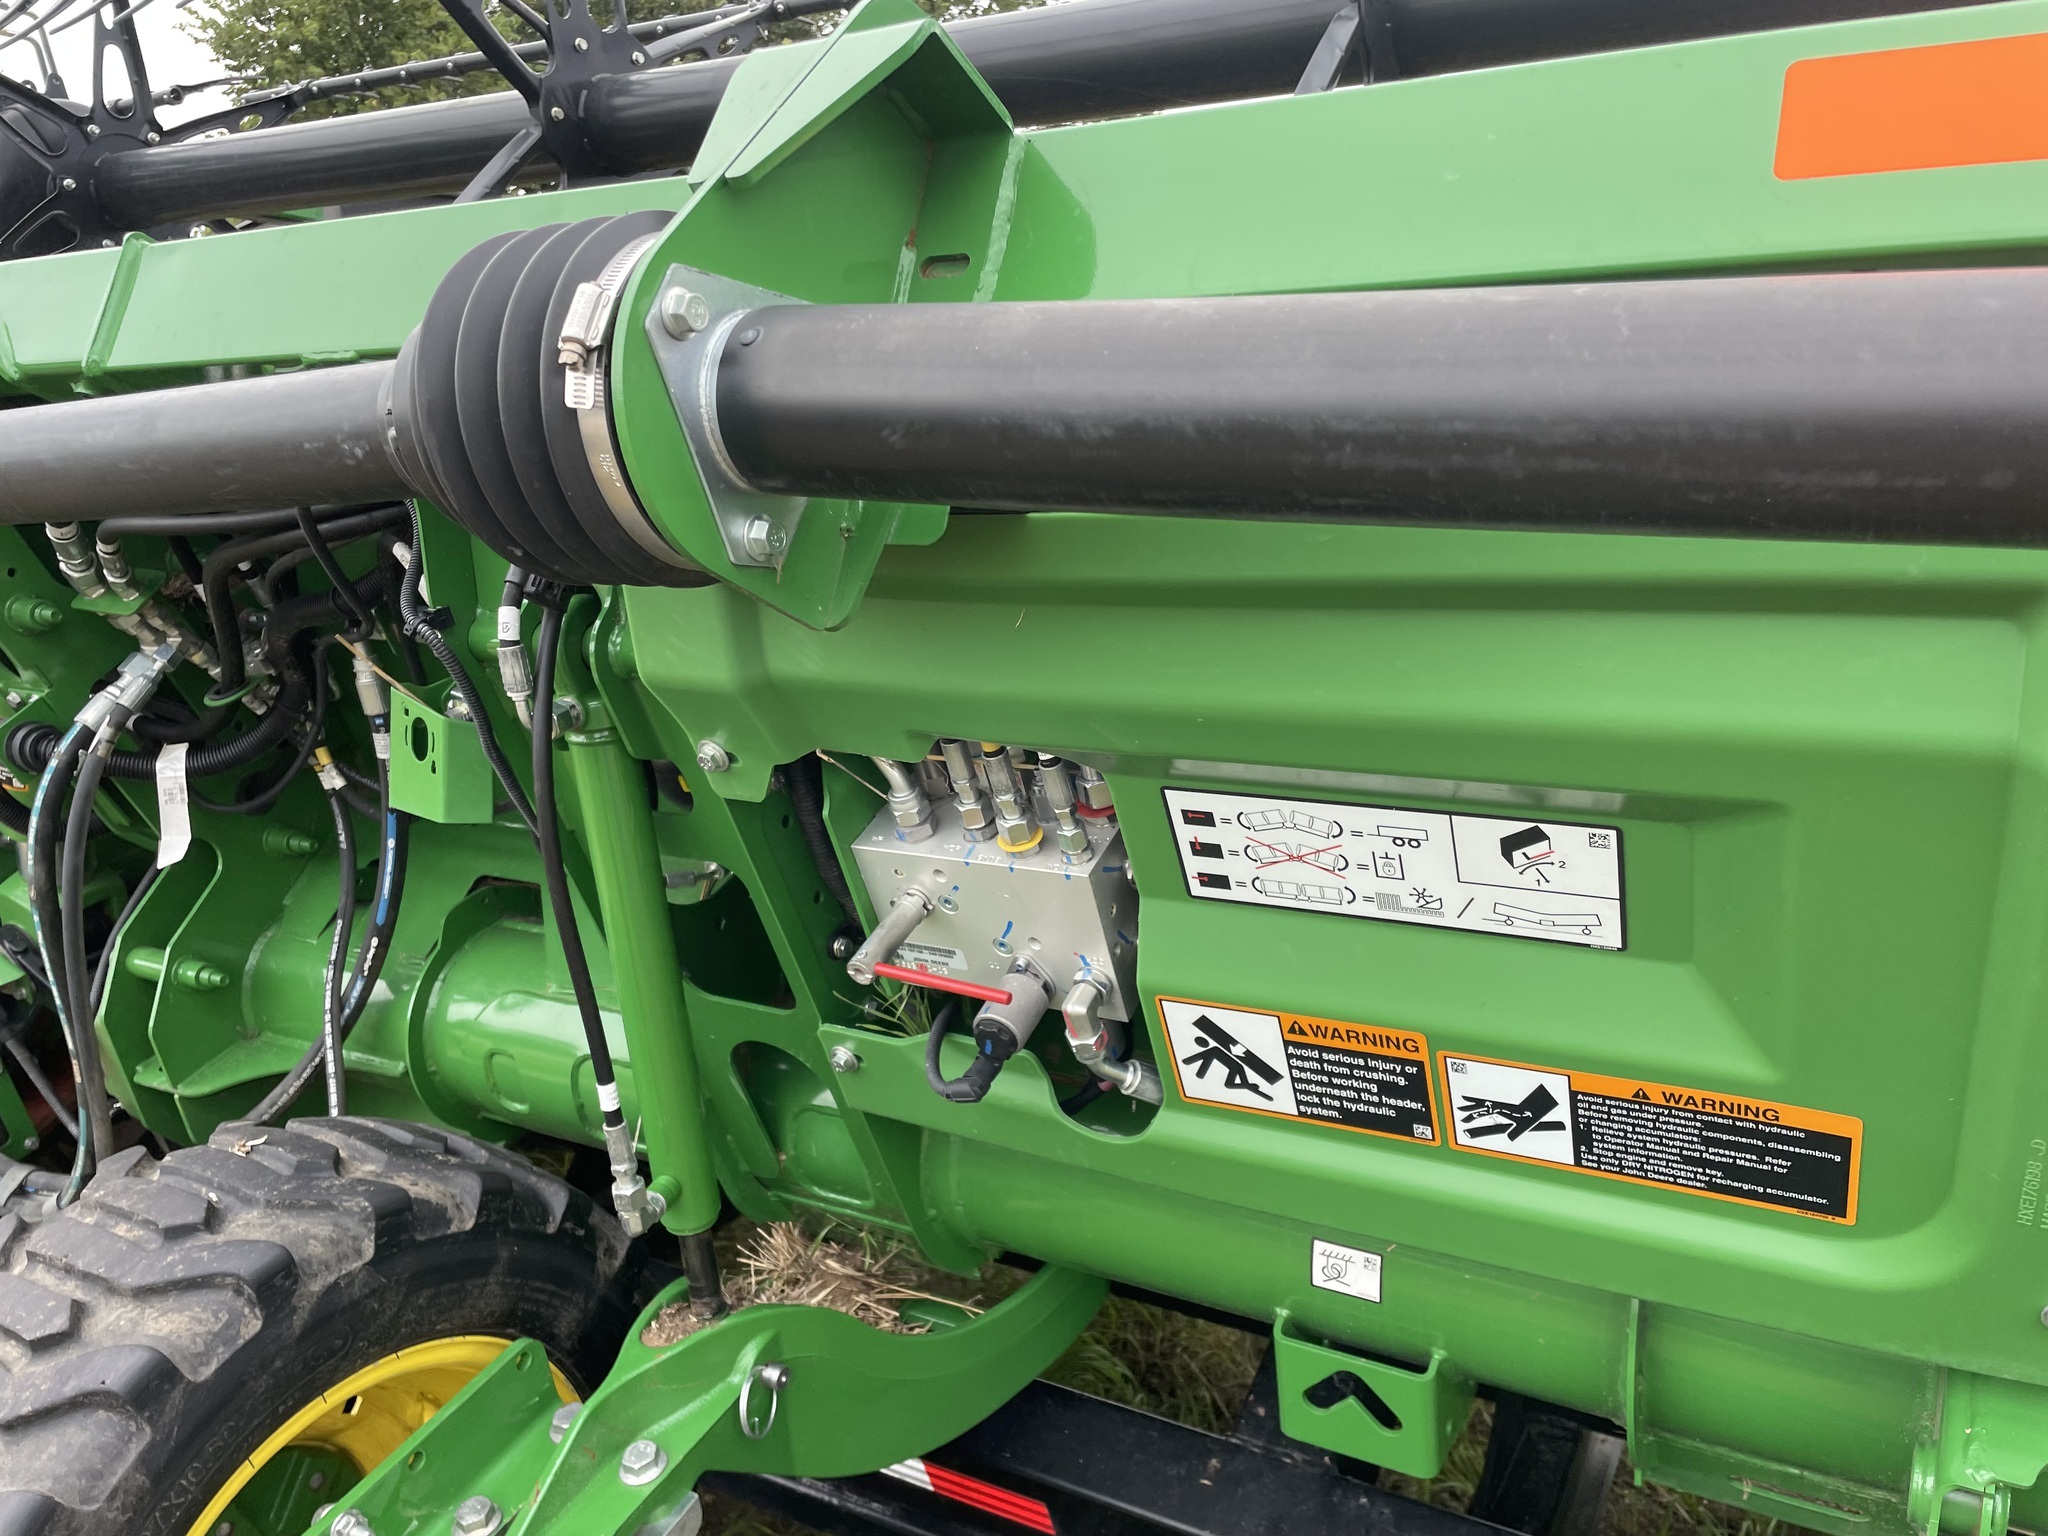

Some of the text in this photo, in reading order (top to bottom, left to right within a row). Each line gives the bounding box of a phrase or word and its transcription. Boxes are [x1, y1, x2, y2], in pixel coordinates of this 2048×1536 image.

[1558, 860, 1566, 869] 2
[1535, 879, 1541, 887] 1
[1308, 1023, 1420, 1054] WARNING
[1287, 1045, 1418, 1074] Avoid serious injury or
[1289, 1057, 1409, 1086] death from crushing.
[1291, 1069, 1378, 1093] Before working
[1294, 1082, 1426, 1112] underneath the header,
[1296, 1092, 1396, 1117] lock the hydraulic
[1299, 1105, 1343, 1119] system.
[1661, 1091, 1781, 1122] WARNING
[1577, 1094, 1805, 1138] Avoid serious injury from contact with hydraulic
[1590, 1104, 1608, 1112] and
[1629, 1111, 1657, 1120] under
[1659, 1115, 1704, 1128] pressure.
[1590, 1119, 1633, 1132] changing
[1635, 1127, 1701, 1143] accumulators:
[1578, 1108, 1841, 1162] Before removing hydraulic components, disassembling
[1591, 1125, 1625, 1137] Relieve
[1626, 1130, 1660, 1143] system
[1662, 1138, 1706, 1151] hydraulic
[1708, 1147, 1760, 1161] pressures.
[1765, 1156, 1792, 1167] Refer
[1592, 1147, 1614, 1157] Stop
[1615, 1152, 1647, 1163] engine
[1648, 1158, 1667, 1166] and
[1668, 1162, 1704, 1173] remove
[1705, 1168, 1724, 1178] key.
[1593, 1141, 1683, 1162] system information.
[1603, 1135, 1644, 1147] Operator
[1646, 1142, 1680, 1154] Manual
[1682, 1150, 1700, 1158] and
[1702, 1152, 1734, 1164] Repair
[1736, 1158, 1771, 1171] Manual
[1773, 1165, 1788, 1174] for
[1580, 1152, 1829, 1205] Use only DRY NITROGEN for recharging accumulator.
[1581, 1159, 1708, 1189] See your John Deere dealer.
[2016, 1139, 2047, 1226] HXE176198 JD
